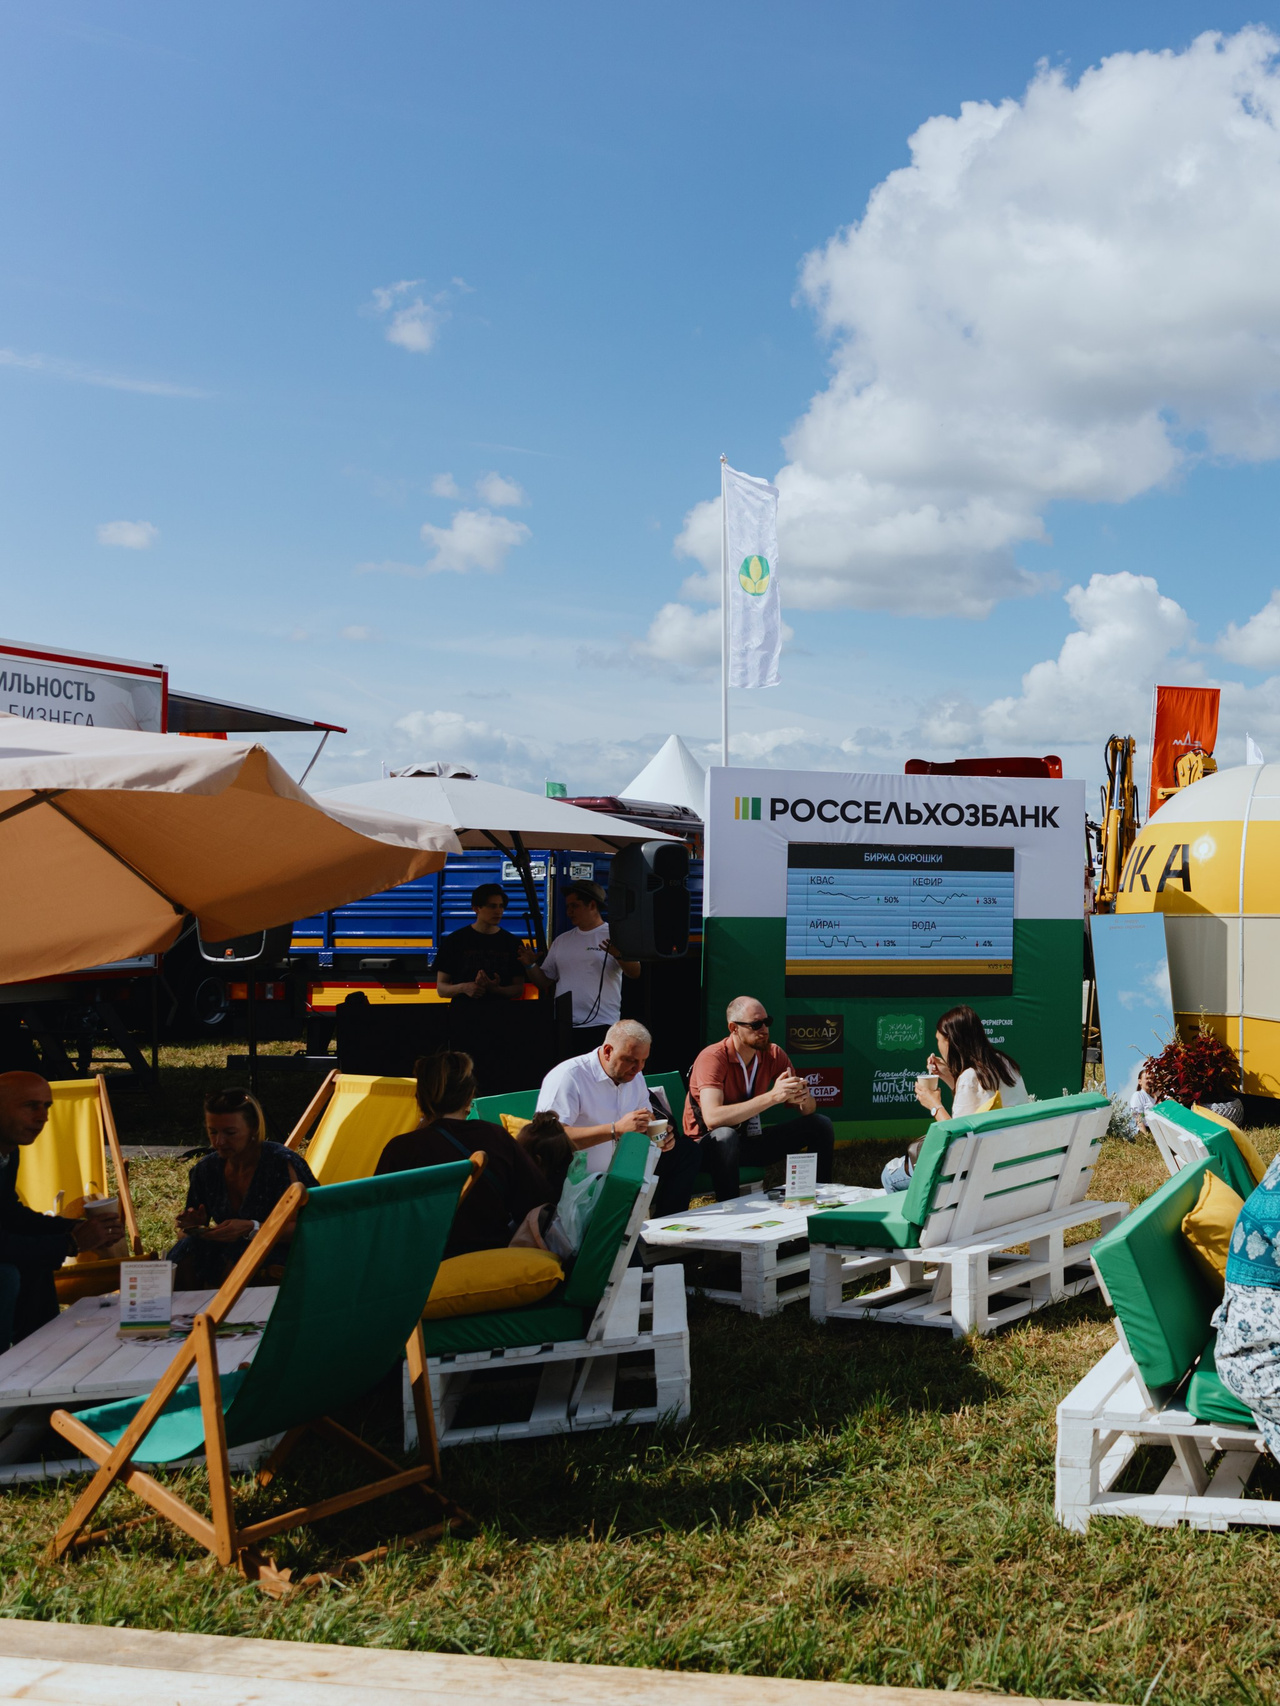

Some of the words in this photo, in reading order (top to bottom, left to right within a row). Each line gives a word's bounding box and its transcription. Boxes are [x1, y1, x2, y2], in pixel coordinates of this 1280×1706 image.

[770, 797, 1060, 828] РОССЕЛЬХОЗБАНК
[864, 853, 896, 863] БИРЖА
[898, 853, 943, 864] ОКРОШКИ
[810, 876, 835, 885] КВАС
[912, 877, 943, 886] КЕФИР
[884, 896, 899, 904] 50%
[809, 919, 840, 929] АЙРАН
[912, 921, 937, 931] ВОДА
[789, 1028, 837, 1038] РОСКАР
[814, 1088, 834, 1096] СТАР
[872, 1093, 918, 1103] МАНУФАКТУ
